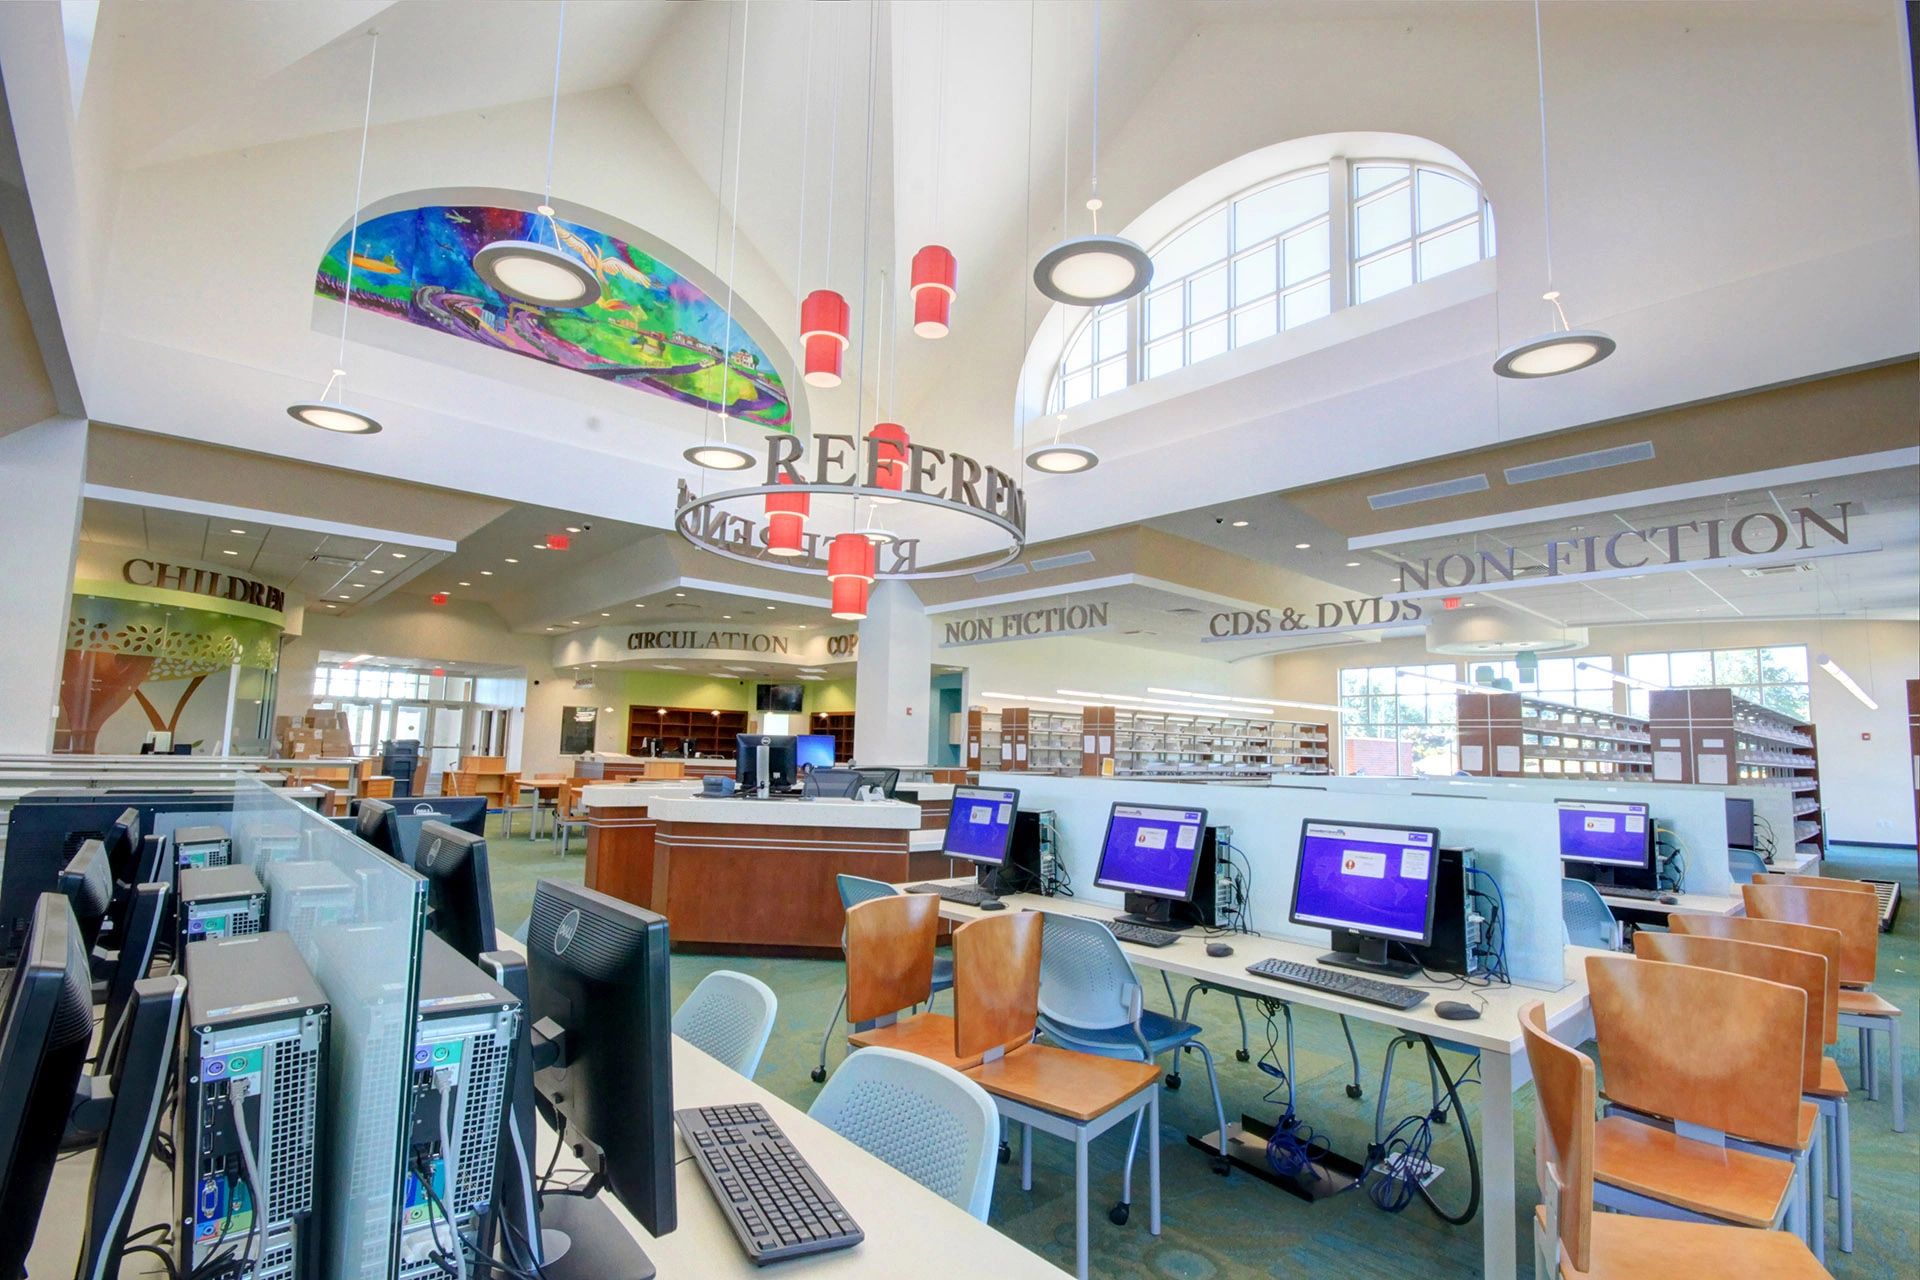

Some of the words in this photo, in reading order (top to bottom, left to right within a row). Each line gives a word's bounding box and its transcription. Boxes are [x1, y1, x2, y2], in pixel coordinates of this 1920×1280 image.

[1396, 546, 1516, 593] NON
[1546, 502, 1852, 577] FICTION
[944, 617, 994, 644] NON
[1001, 602, 1109, 637] FICTION
[1209, 609, 1272, 637] CDS
[1279, 607, 1309, 632] &
[1315, 597, 1422, 629] DVDS
[627, 630, 788, 654] CIRCULATION
